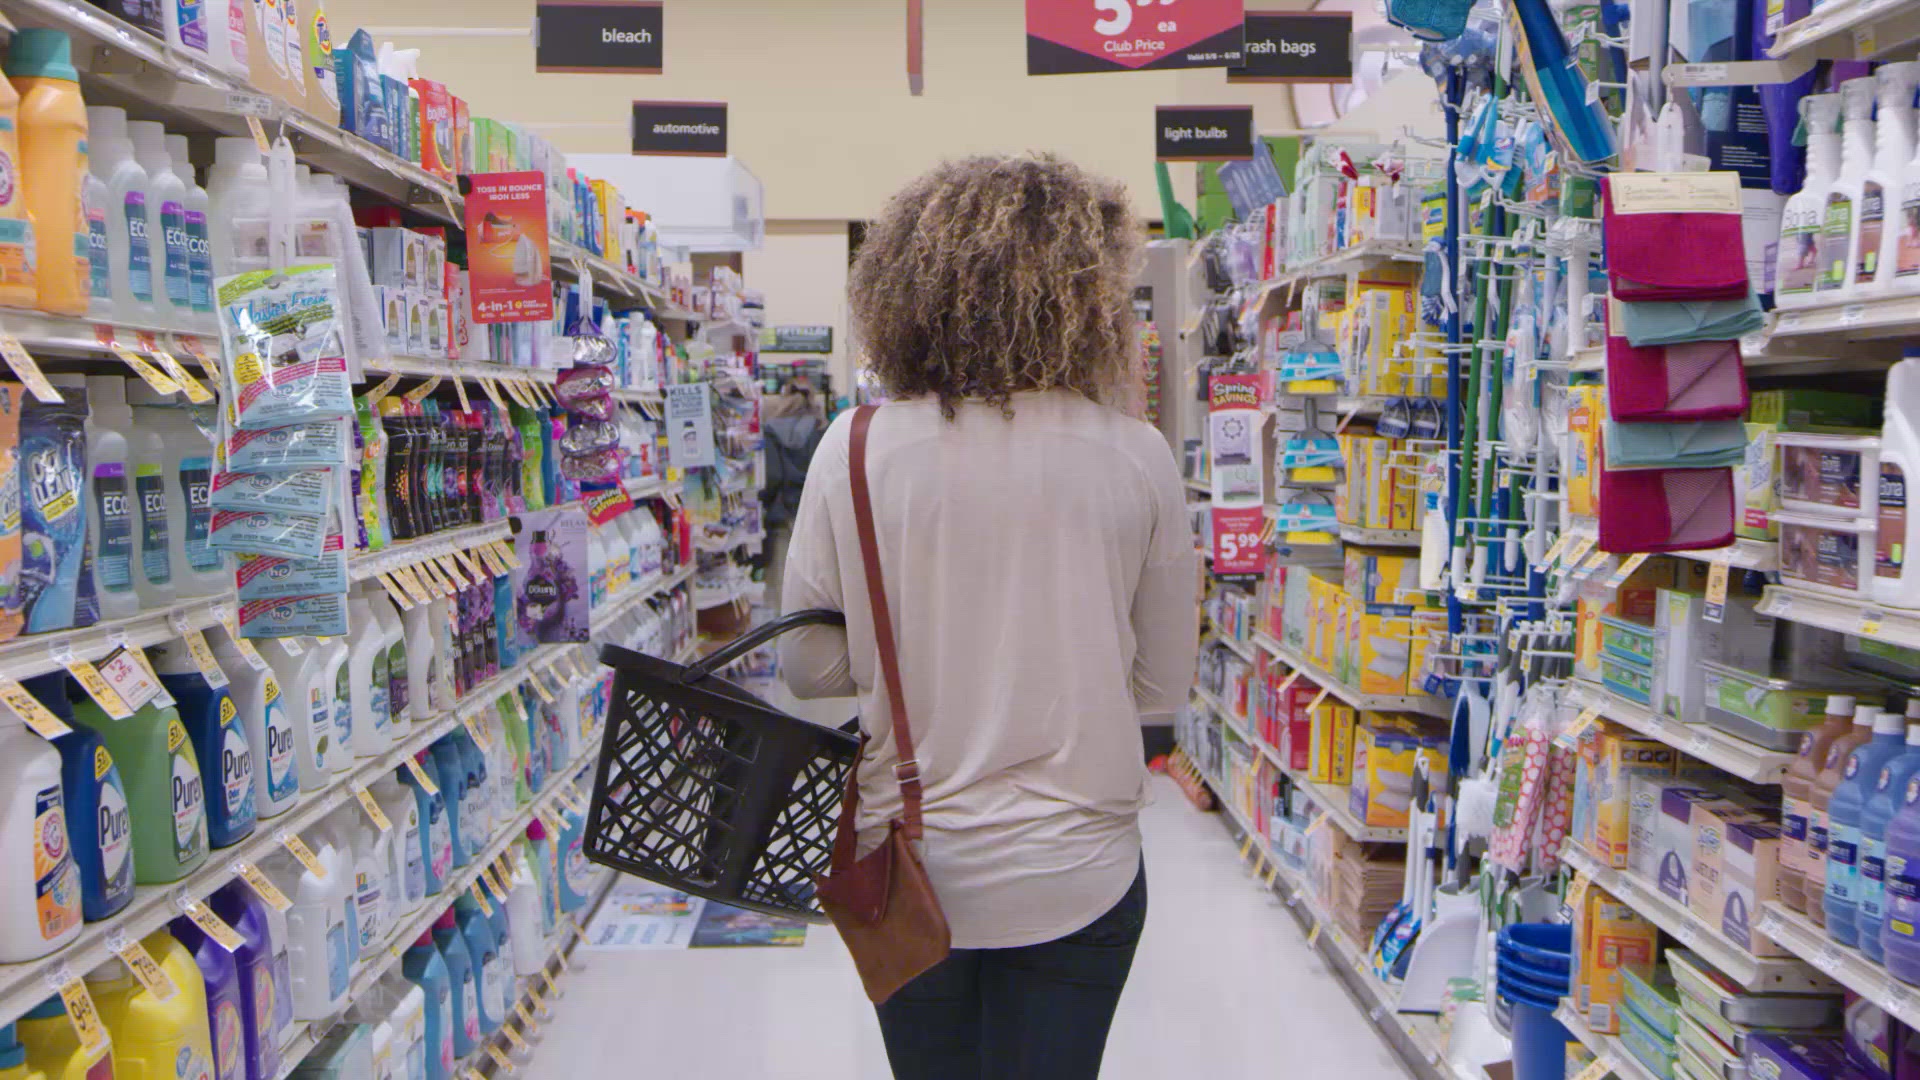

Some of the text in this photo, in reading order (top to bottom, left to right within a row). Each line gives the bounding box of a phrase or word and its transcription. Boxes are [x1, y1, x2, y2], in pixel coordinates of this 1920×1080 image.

[1157, 20, 1177, 33] ea
[601, 27, 652, 43] bleach
[1103, 39, 1165, 52] Club Price
[1245, 39, 1317, 57] rash bags
[652, 123, 720, 135] automotive
[1164, 126, 1228, 140] light bulbs
[476, 183, 542, 194] TOSS IN BOUNCE
[489, 192, 530, 201] IRON LESS
[165, 229, 188, 247] ECO
[187, 238, 210, 256] COS
[477, 300, 513, 313] 4-in-1
[1213, 382, 1257, 397] Spring
[1212, 393, 1258, 407] SAVINGS
[189, 486, 209, 505] EC
[103, 495, 130, 516] ECO
[527, 584, 557, 596] Downy
[267, 725, 294, 759] Pure
[223, 748, 252, 784] Pure
[173, 775, 202, 813] Pure
[100, 805, 129, 847] Pure
